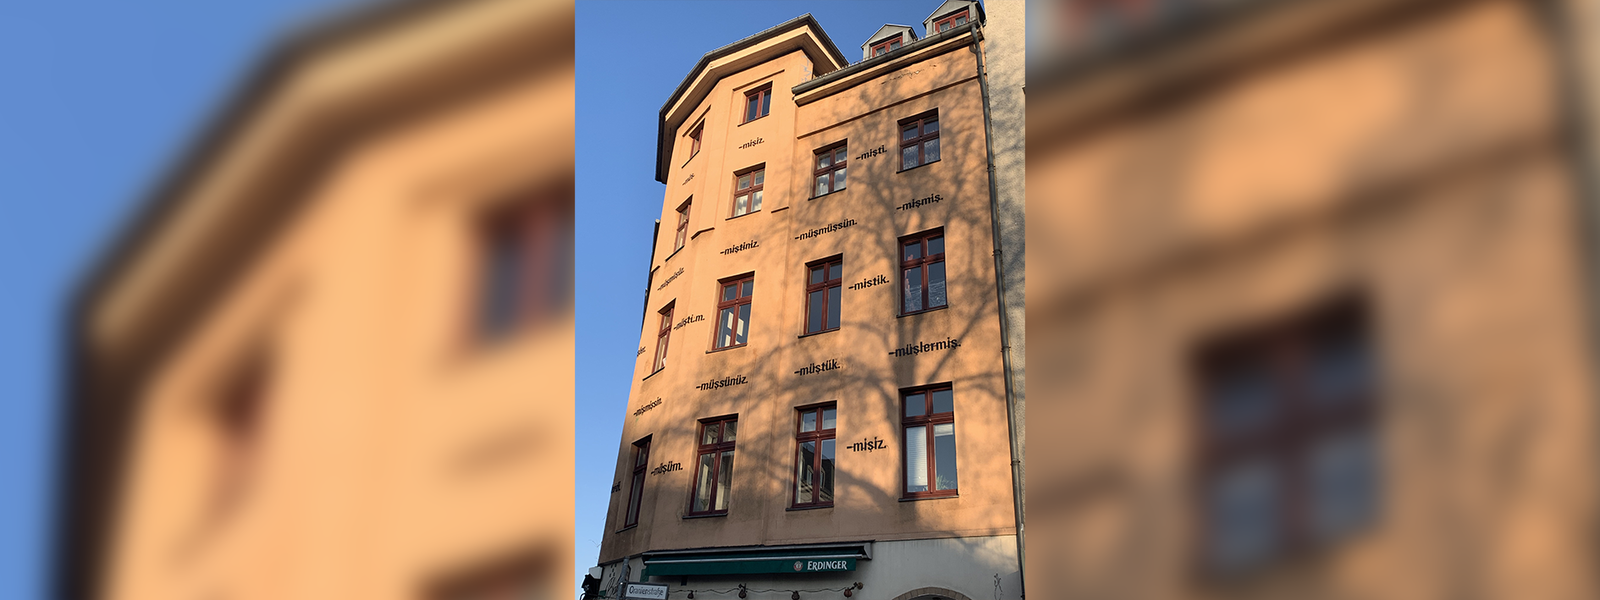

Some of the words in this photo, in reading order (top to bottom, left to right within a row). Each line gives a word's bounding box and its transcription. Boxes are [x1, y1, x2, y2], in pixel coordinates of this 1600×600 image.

[896, 193, 943, 211] -mişmiş.
[795, 218, 858, 240] -müşmüşsün.
[888, 337, 961, 357] -müşlermiş.
[794, 359, 840, 376] -müştük.
[696, 375, 748, 391] -müşsünüz.
[846, 437, 887, 453] -mişiz.
[806, 560, 848, 572] ERDINGER
[629, 586, 664, 598] Oranienstraße
